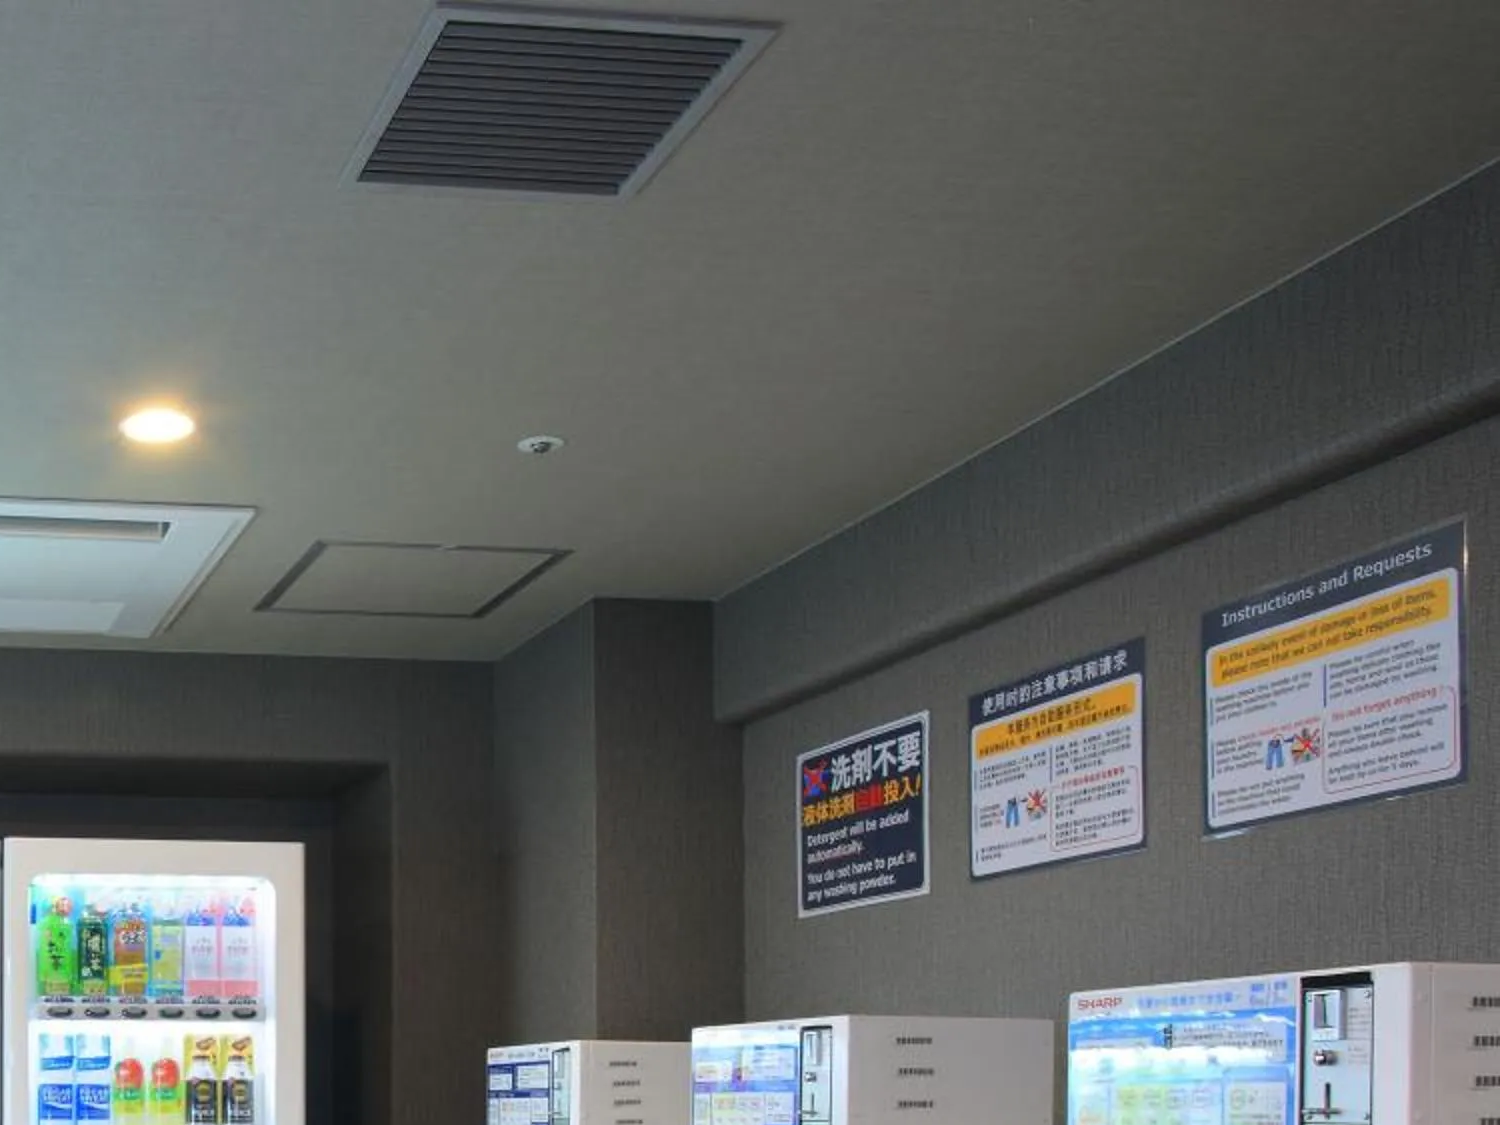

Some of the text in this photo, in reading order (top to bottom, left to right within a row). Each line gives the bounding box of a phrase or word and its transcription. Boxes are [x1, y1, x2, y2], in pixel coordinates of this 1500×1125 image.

[1221, 543, 1433, 628] Instructions and Requests
[831, 731, 921, 792] 洗剤不要
[808, 808, 909, 848] Detergent will be added
[808, 850, 916, 884] You do not have to put in
[808, 887, 822, 903] any
[824, 881, 857, 898] washing
[1078, 996, 1123, 1011] SHARP
